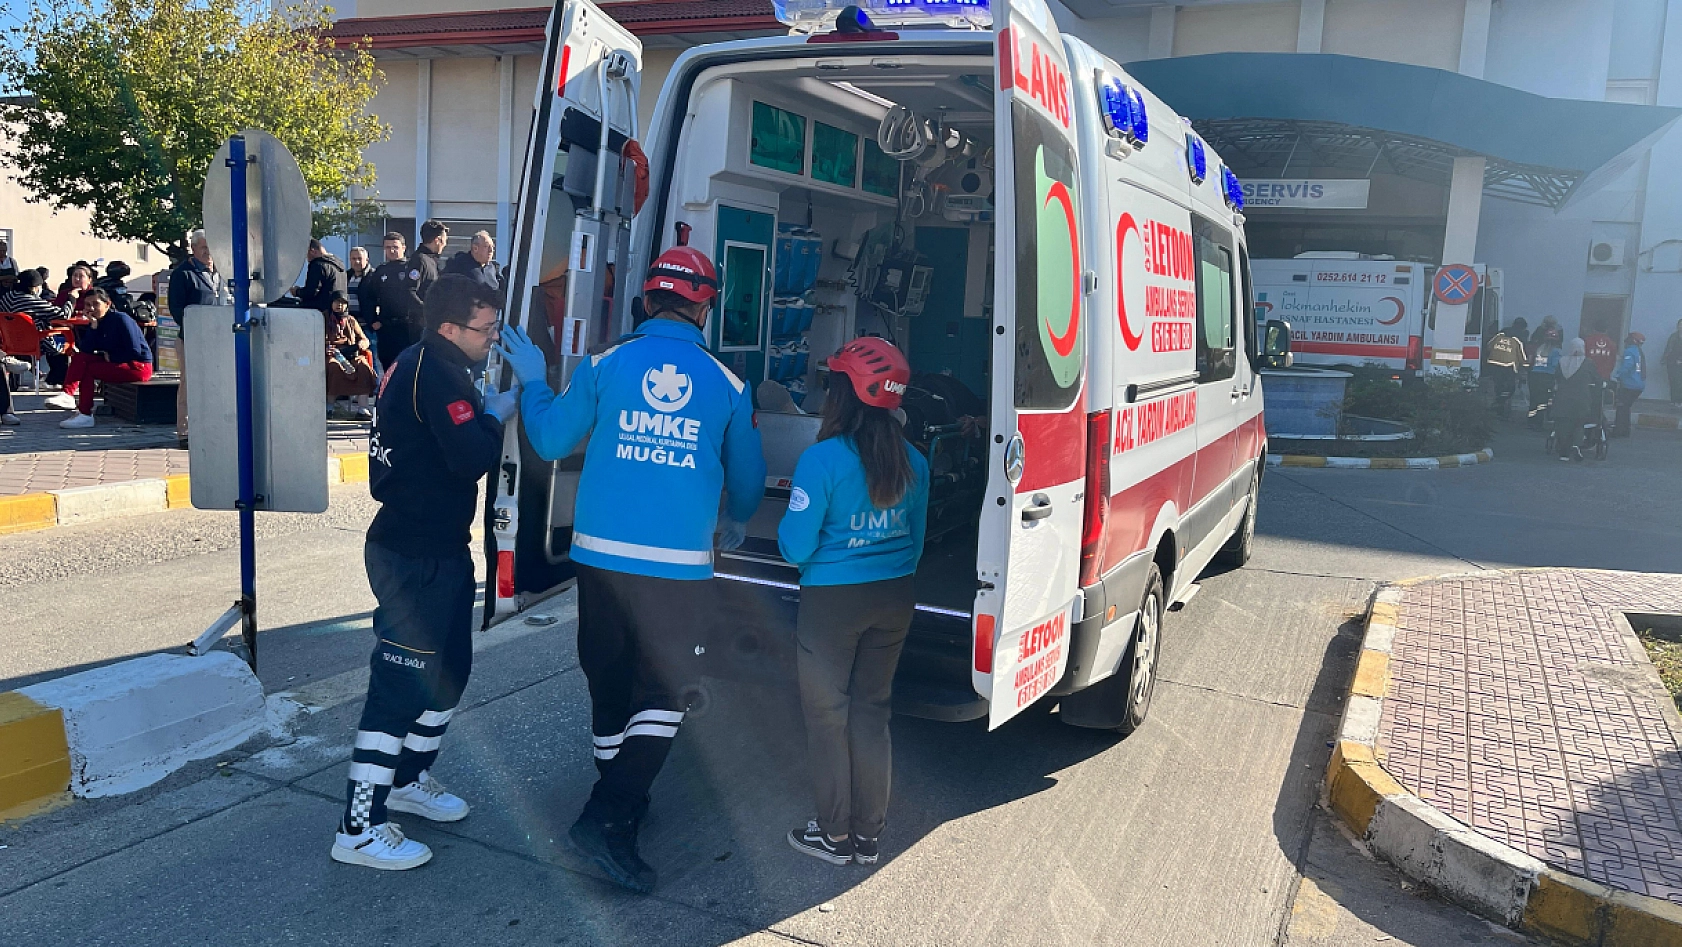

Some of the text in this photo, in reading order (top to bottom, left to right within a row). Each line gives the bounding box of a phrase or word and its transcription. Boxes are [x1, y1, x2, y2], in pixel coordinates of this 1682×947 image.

[1010, 24, 1070, 129] LANS
[1242, 181, 1324, 199] SERVİS
[1150, 219, 1195, 282] LETOON
[1375, 275, 1387, 284] 12
[1281, 298, 1371, 313] lokmanhekim
[1311, 331, 1345, 343] YARDIM
[1347, 333, 1400, 345] AMBULANSI
[619, 409, 701, 441] UMKE
[1113, 407, 1134, 456] ACİL
[1137, 400, 1164, 447] YARDIM
[616, 443, 696, 469] MUĞLA
[850, 508, 906, 531] UMK
[1023, 611, 1065, 659] LETOON
